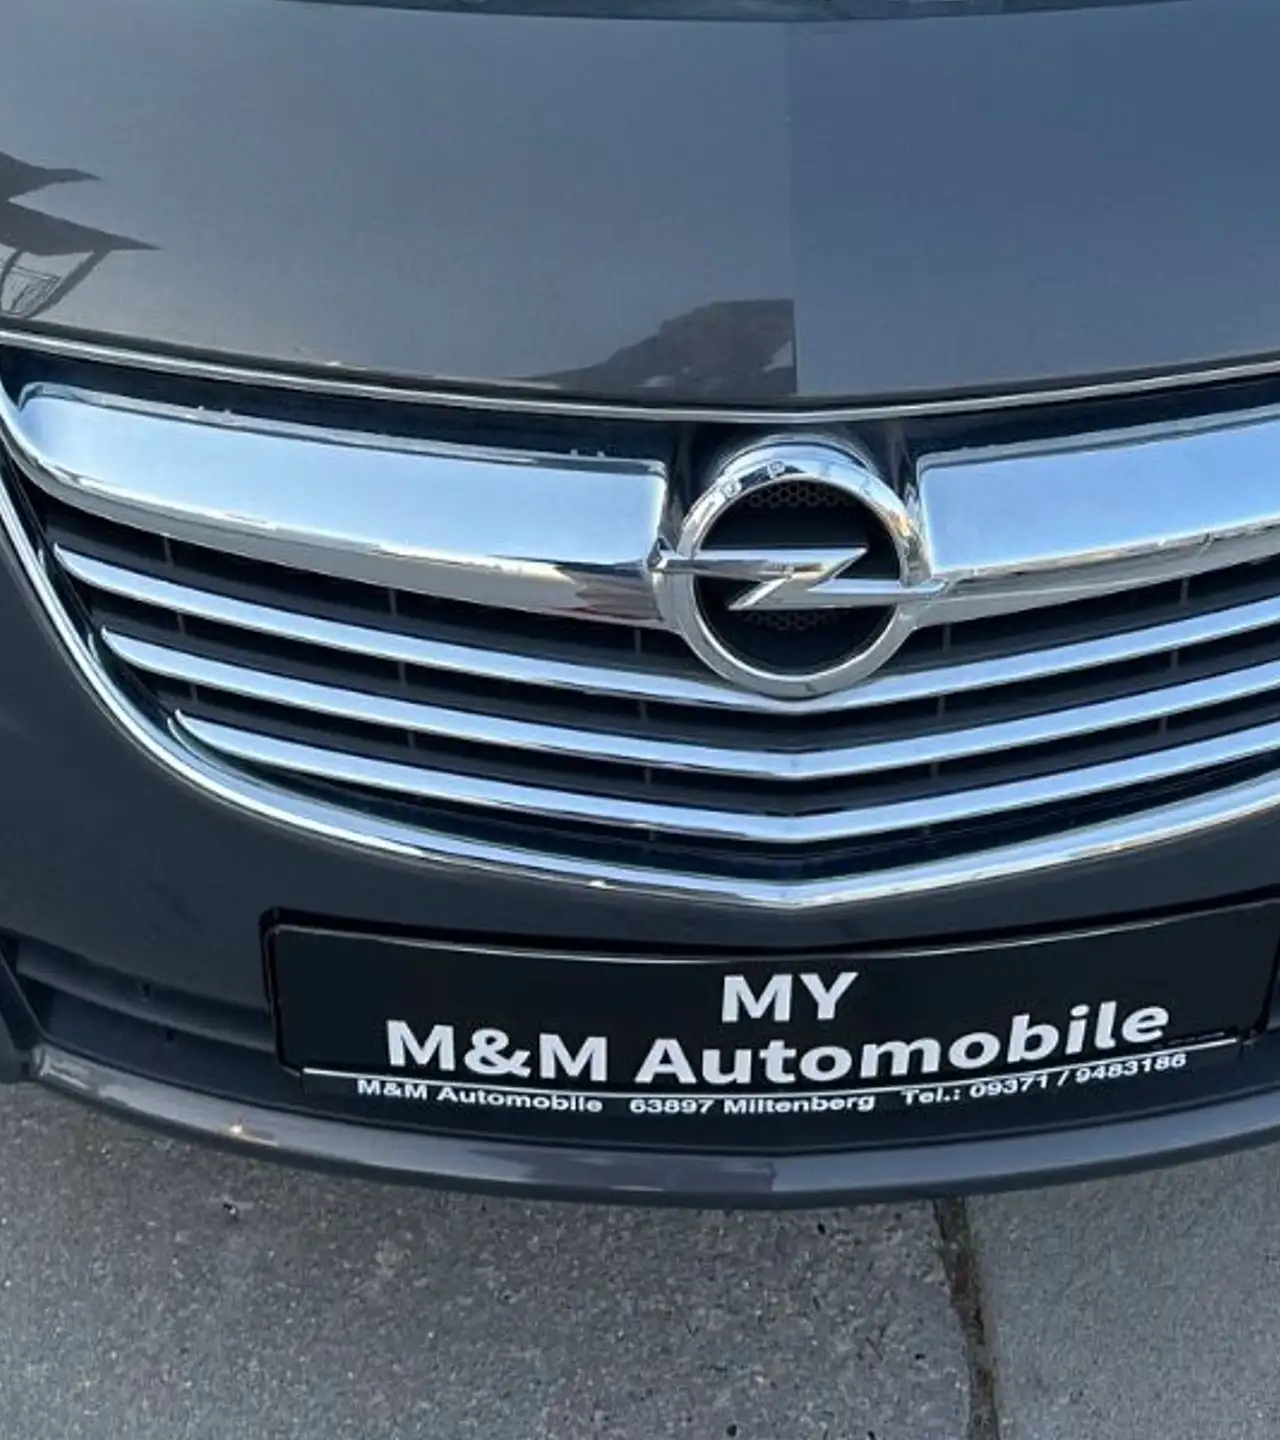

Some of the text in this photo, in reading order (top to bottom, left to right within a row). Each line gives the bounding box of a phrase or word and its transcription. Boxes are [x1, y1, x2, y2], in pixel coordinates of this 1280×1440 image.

[720, 971, 859, 1024] MY
[385, 1000, 1170, 1085] M&M Automobile
[356, 1079, 428, 1101] M&M
[436, 1086, 604, 1113] Automobile
[629, 1098, 715, 1115] 63897
[723, 1094, 876, 1115] Miltenberg
[901, 1089, 961, 1105] Tel.:
[969, 1073, 1049, 1099] 09371
[1075, 1053, 1188, 1083] 9483186
